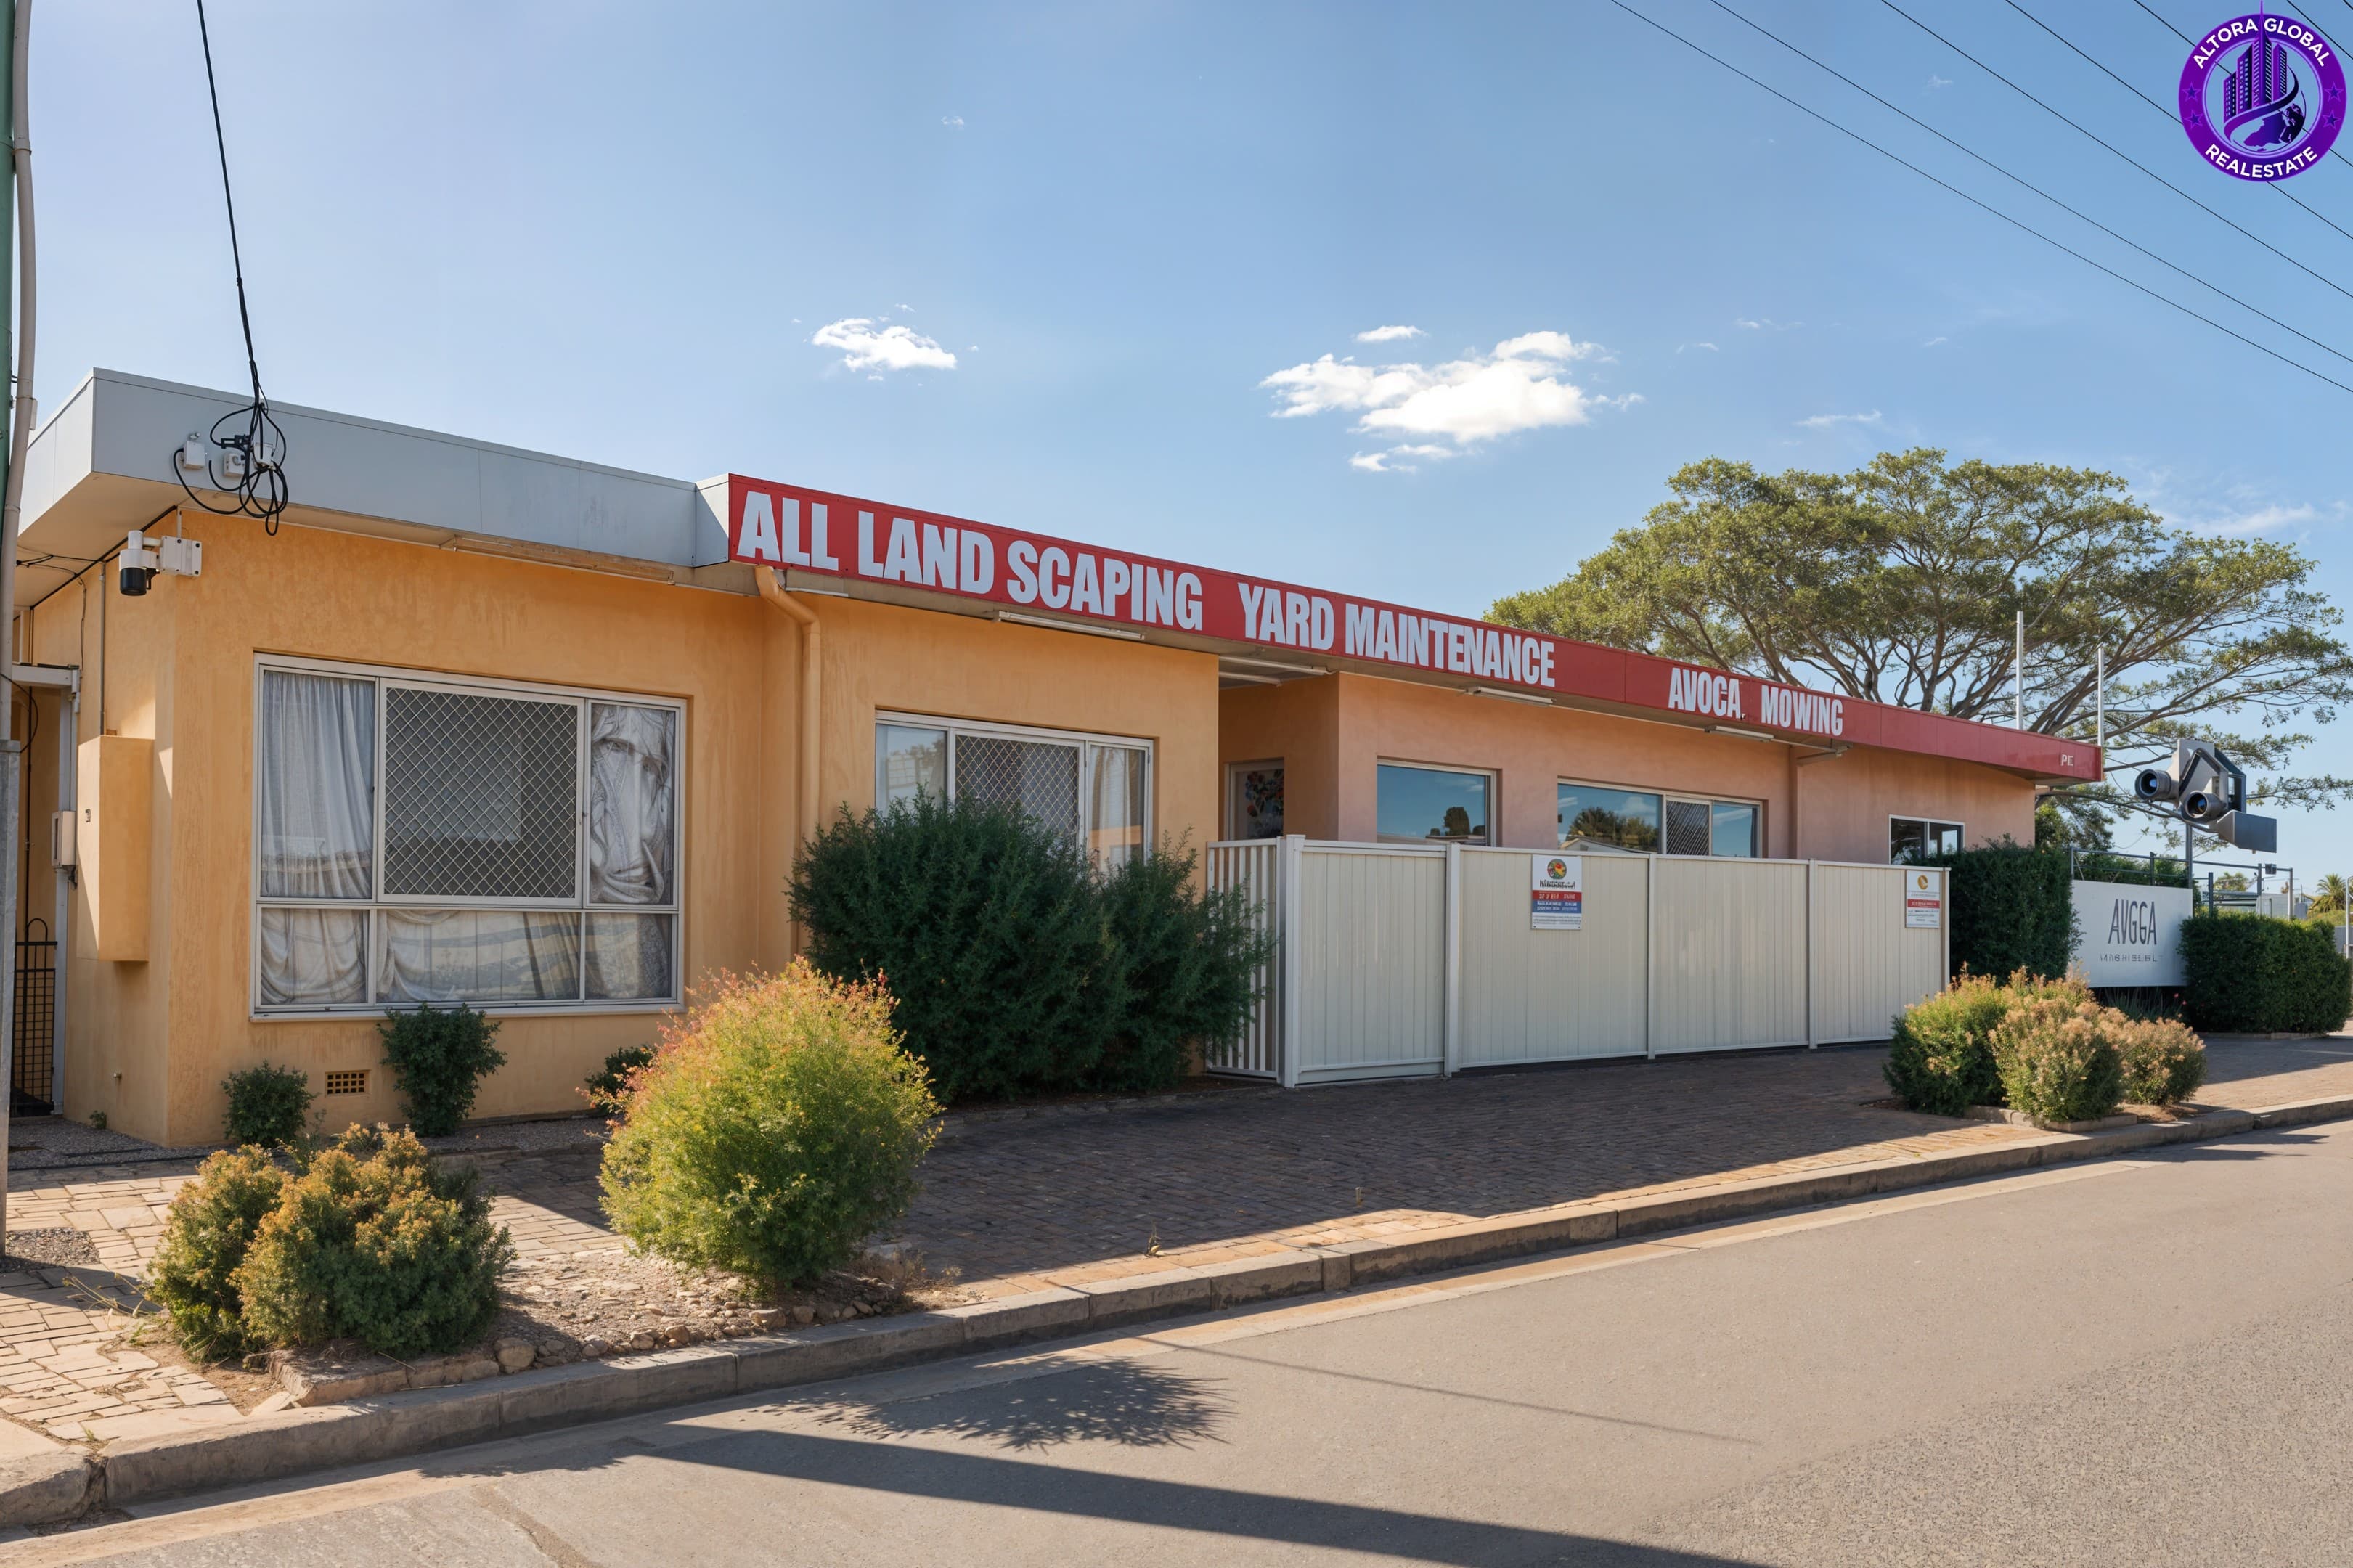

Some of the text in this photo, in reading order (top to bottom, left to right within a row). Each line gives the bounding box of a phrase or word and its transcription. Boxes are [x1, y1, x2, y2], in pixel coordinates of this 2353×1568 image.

[736, 490, 839, 571] ALL
[857, 510, 995, 595] LAND
[1006, 539, 1203, 632] SCAPING
[1236, 581, 1335, 651] YARD
[1345, 602, 1555, 688] MAINTENANCE
[1668, 667, 1742, 719] AVOCA
[1761, 685, 1844, 737] MOWING
